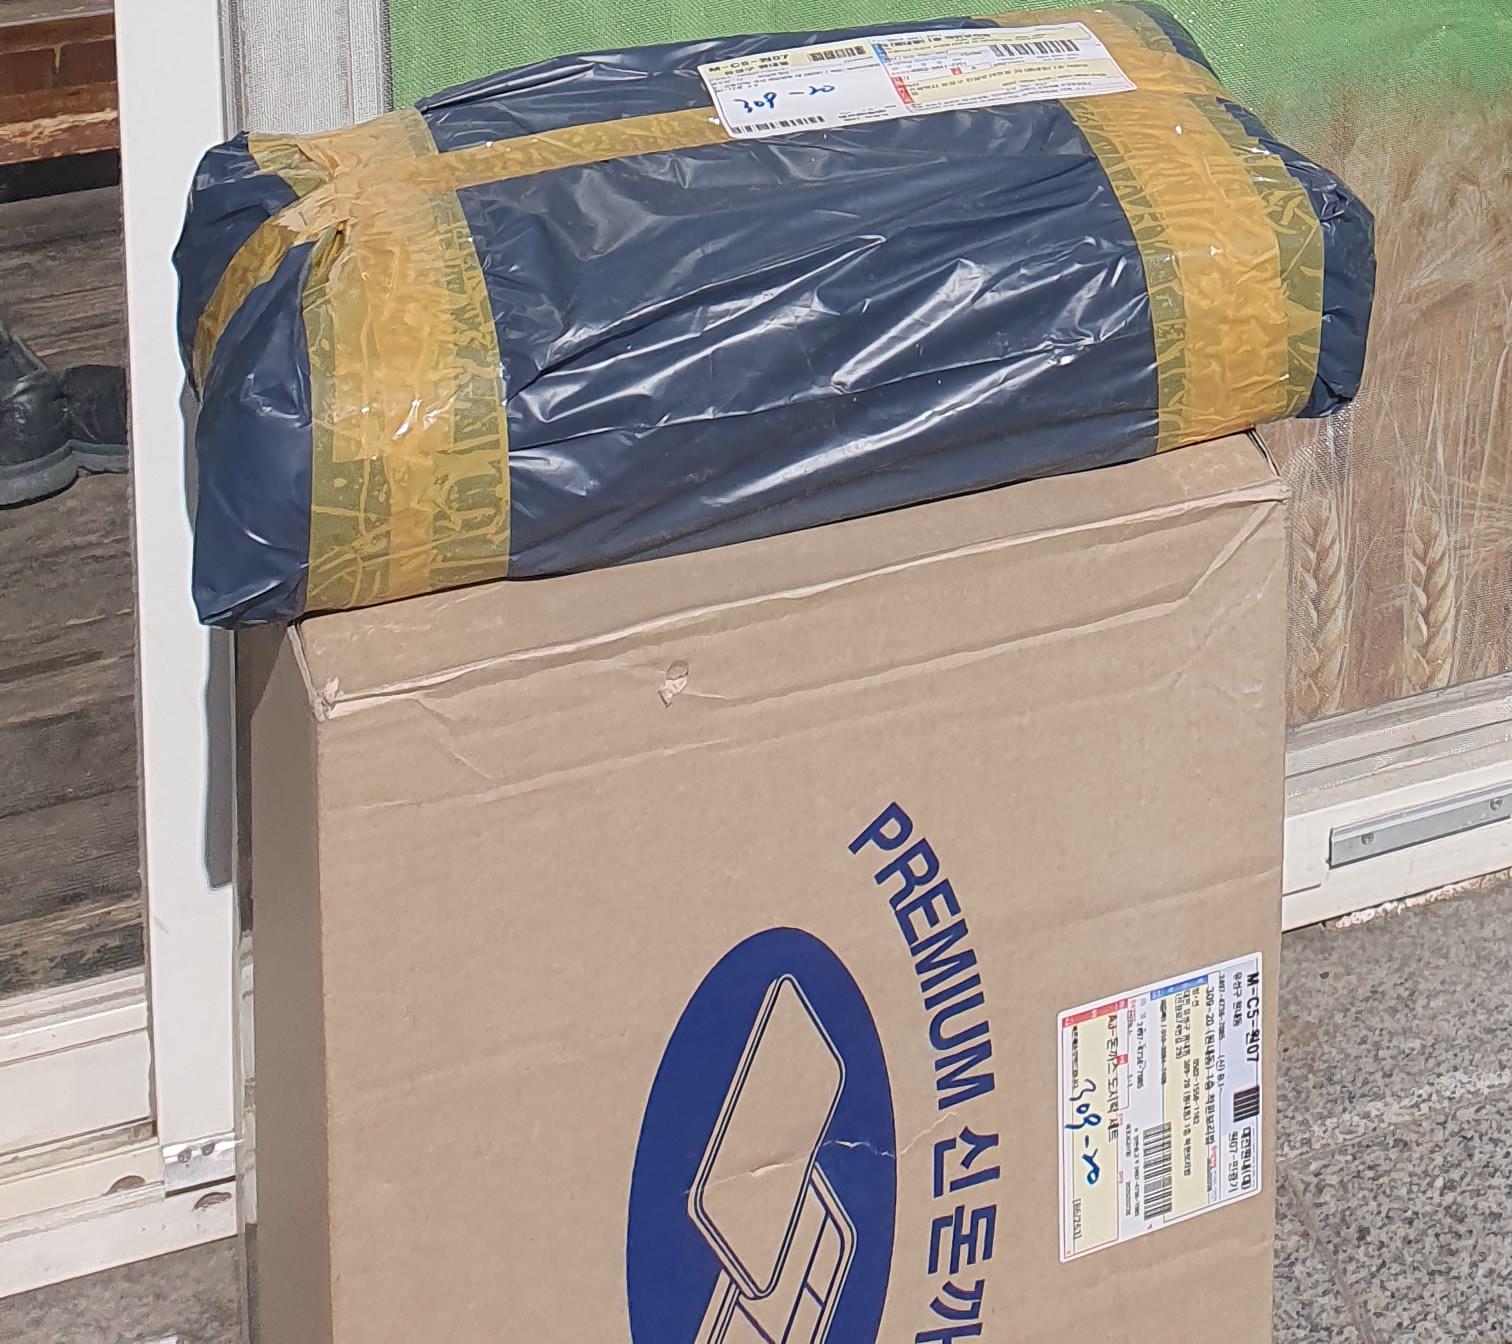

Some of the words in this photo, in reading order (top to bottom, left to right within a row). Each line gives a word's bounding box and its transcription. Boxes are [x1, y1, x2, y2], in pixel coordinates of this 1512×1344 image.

[848, 801, 996, 1110] PREMIUM
[1205, 985, 1214, 1027] 309-20
[1246, 971, 1260, 1063] M-C5-원07
